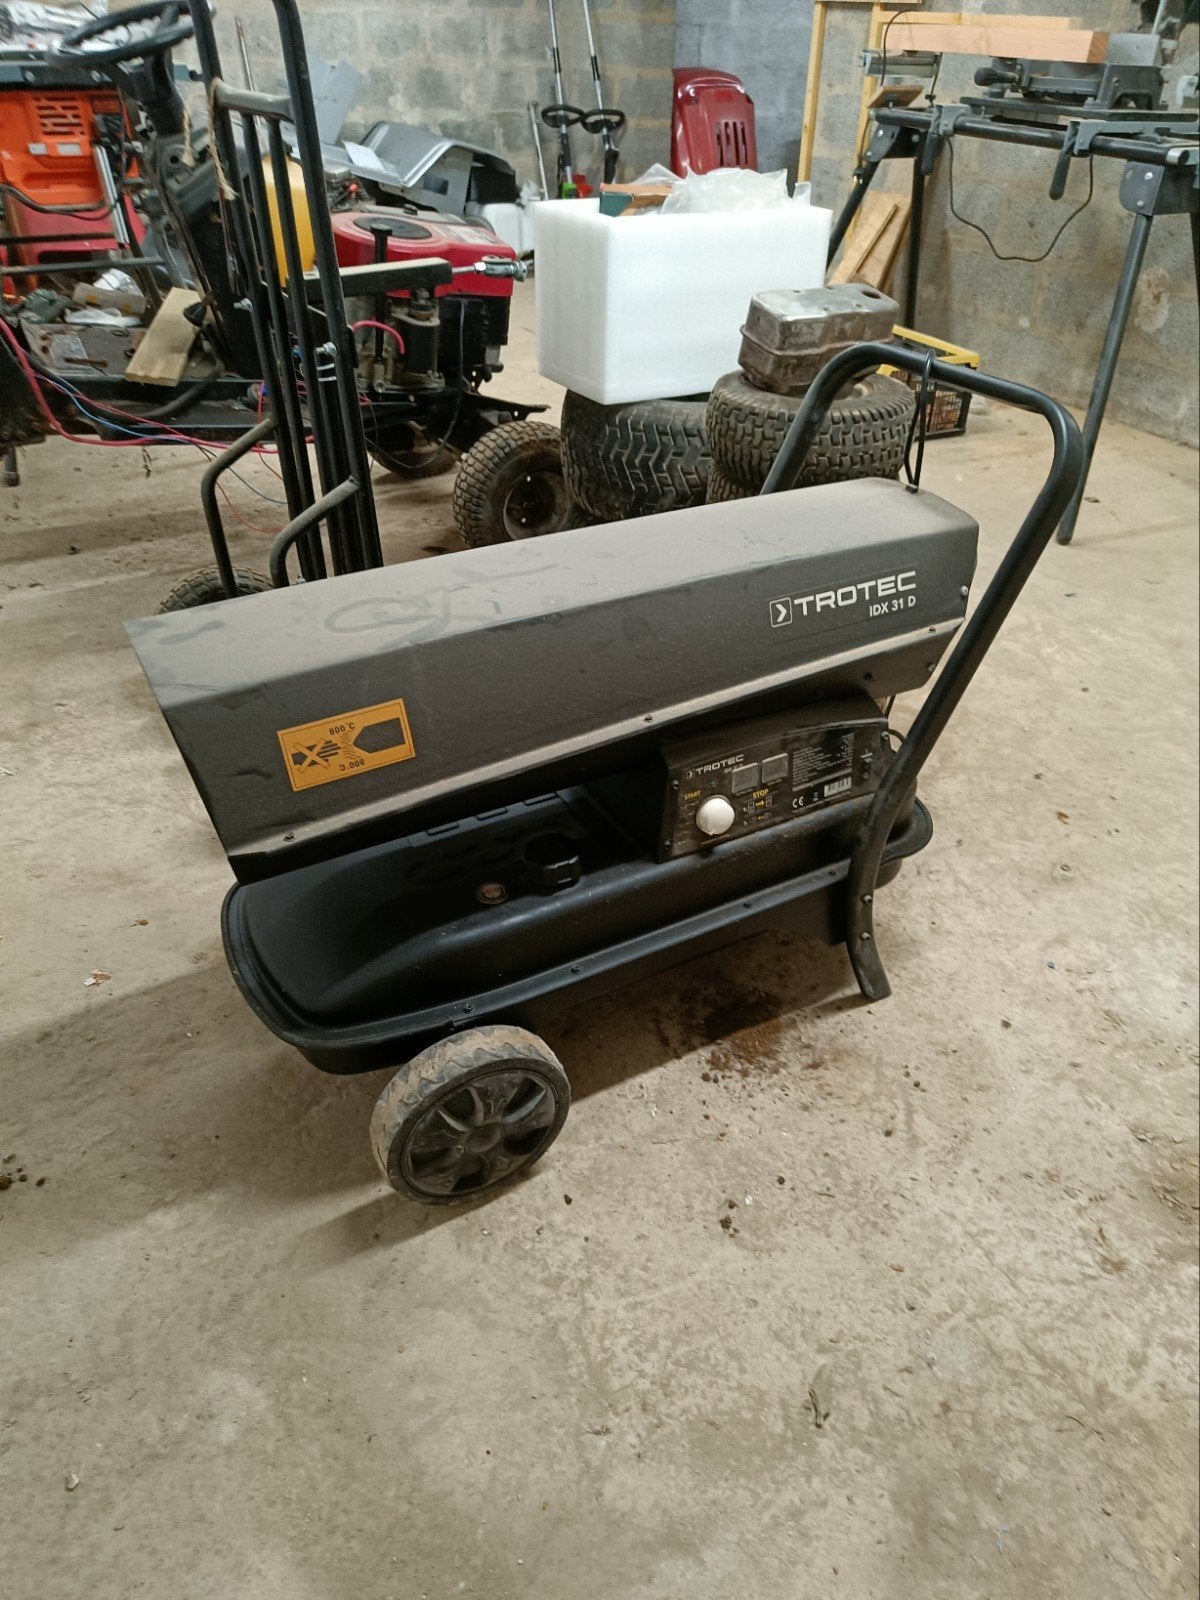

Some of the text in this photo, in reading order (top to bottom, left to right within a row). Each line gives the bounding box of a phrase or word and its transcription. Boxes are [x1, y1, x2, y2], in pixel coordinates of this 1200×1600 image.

[793, 570, 917, 616] TROTEC
[869, 595, 917, 617] IDX 31 D
[695, 754, 745, 775] TROTEC
[752, 788, 769, 799] STOP
